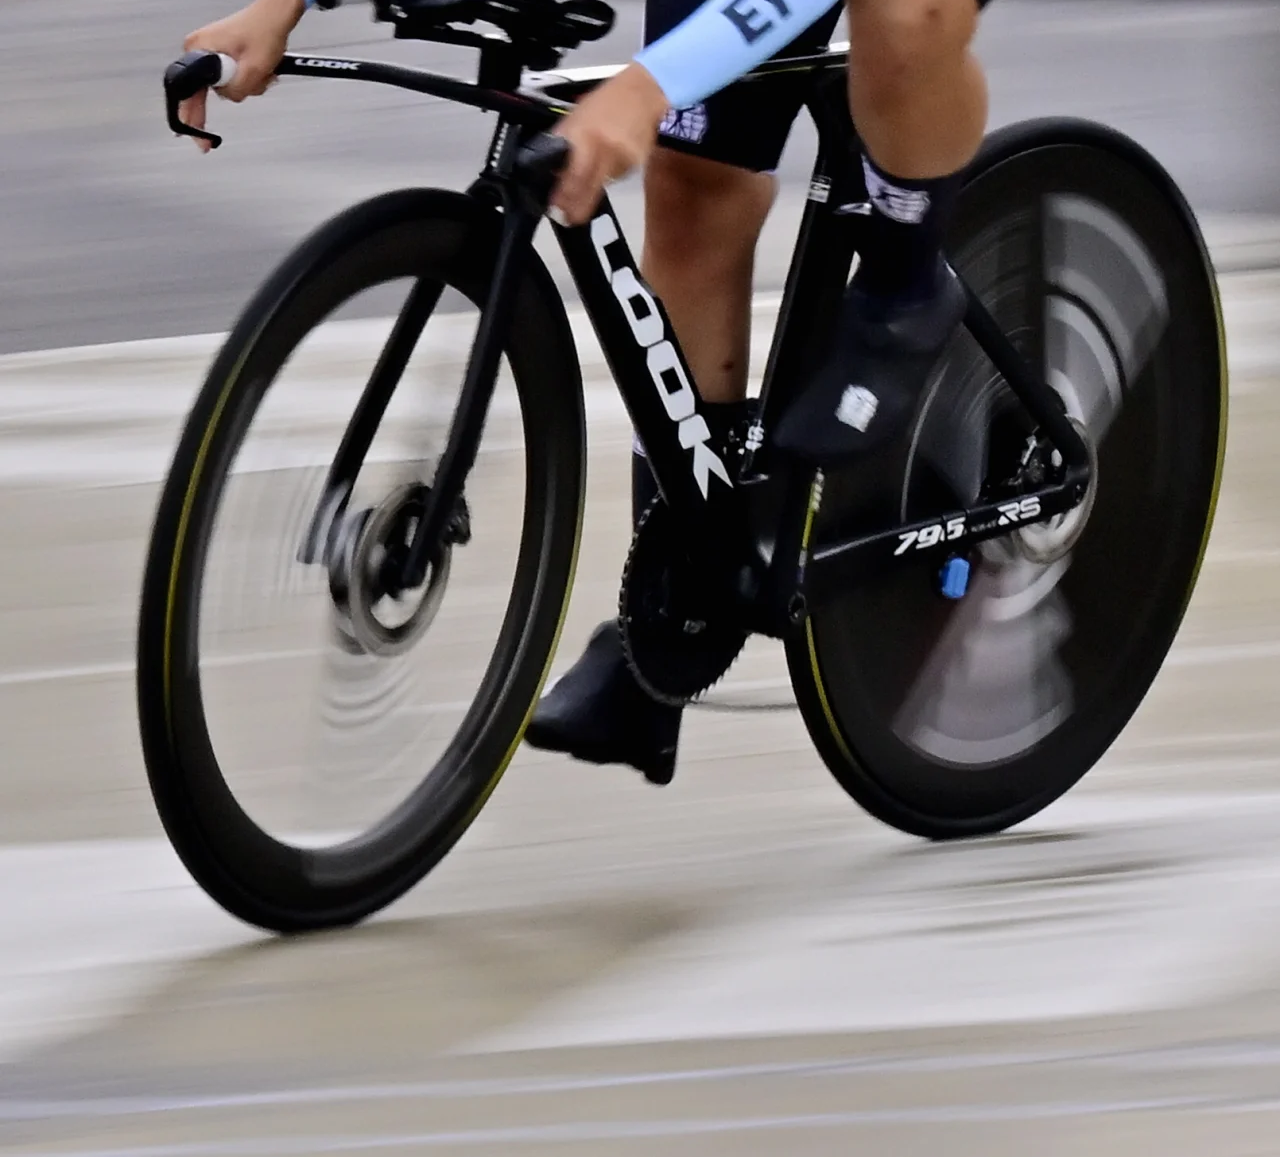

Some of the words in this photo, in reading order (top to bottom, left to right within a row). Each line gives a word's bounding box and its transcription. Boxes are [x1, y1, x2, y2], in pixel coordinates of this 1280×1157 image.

[294, 57, 361, 71] LOOK
[590, 212, 734, 502] LOOK
[997, 496, 1042, 526] RS
